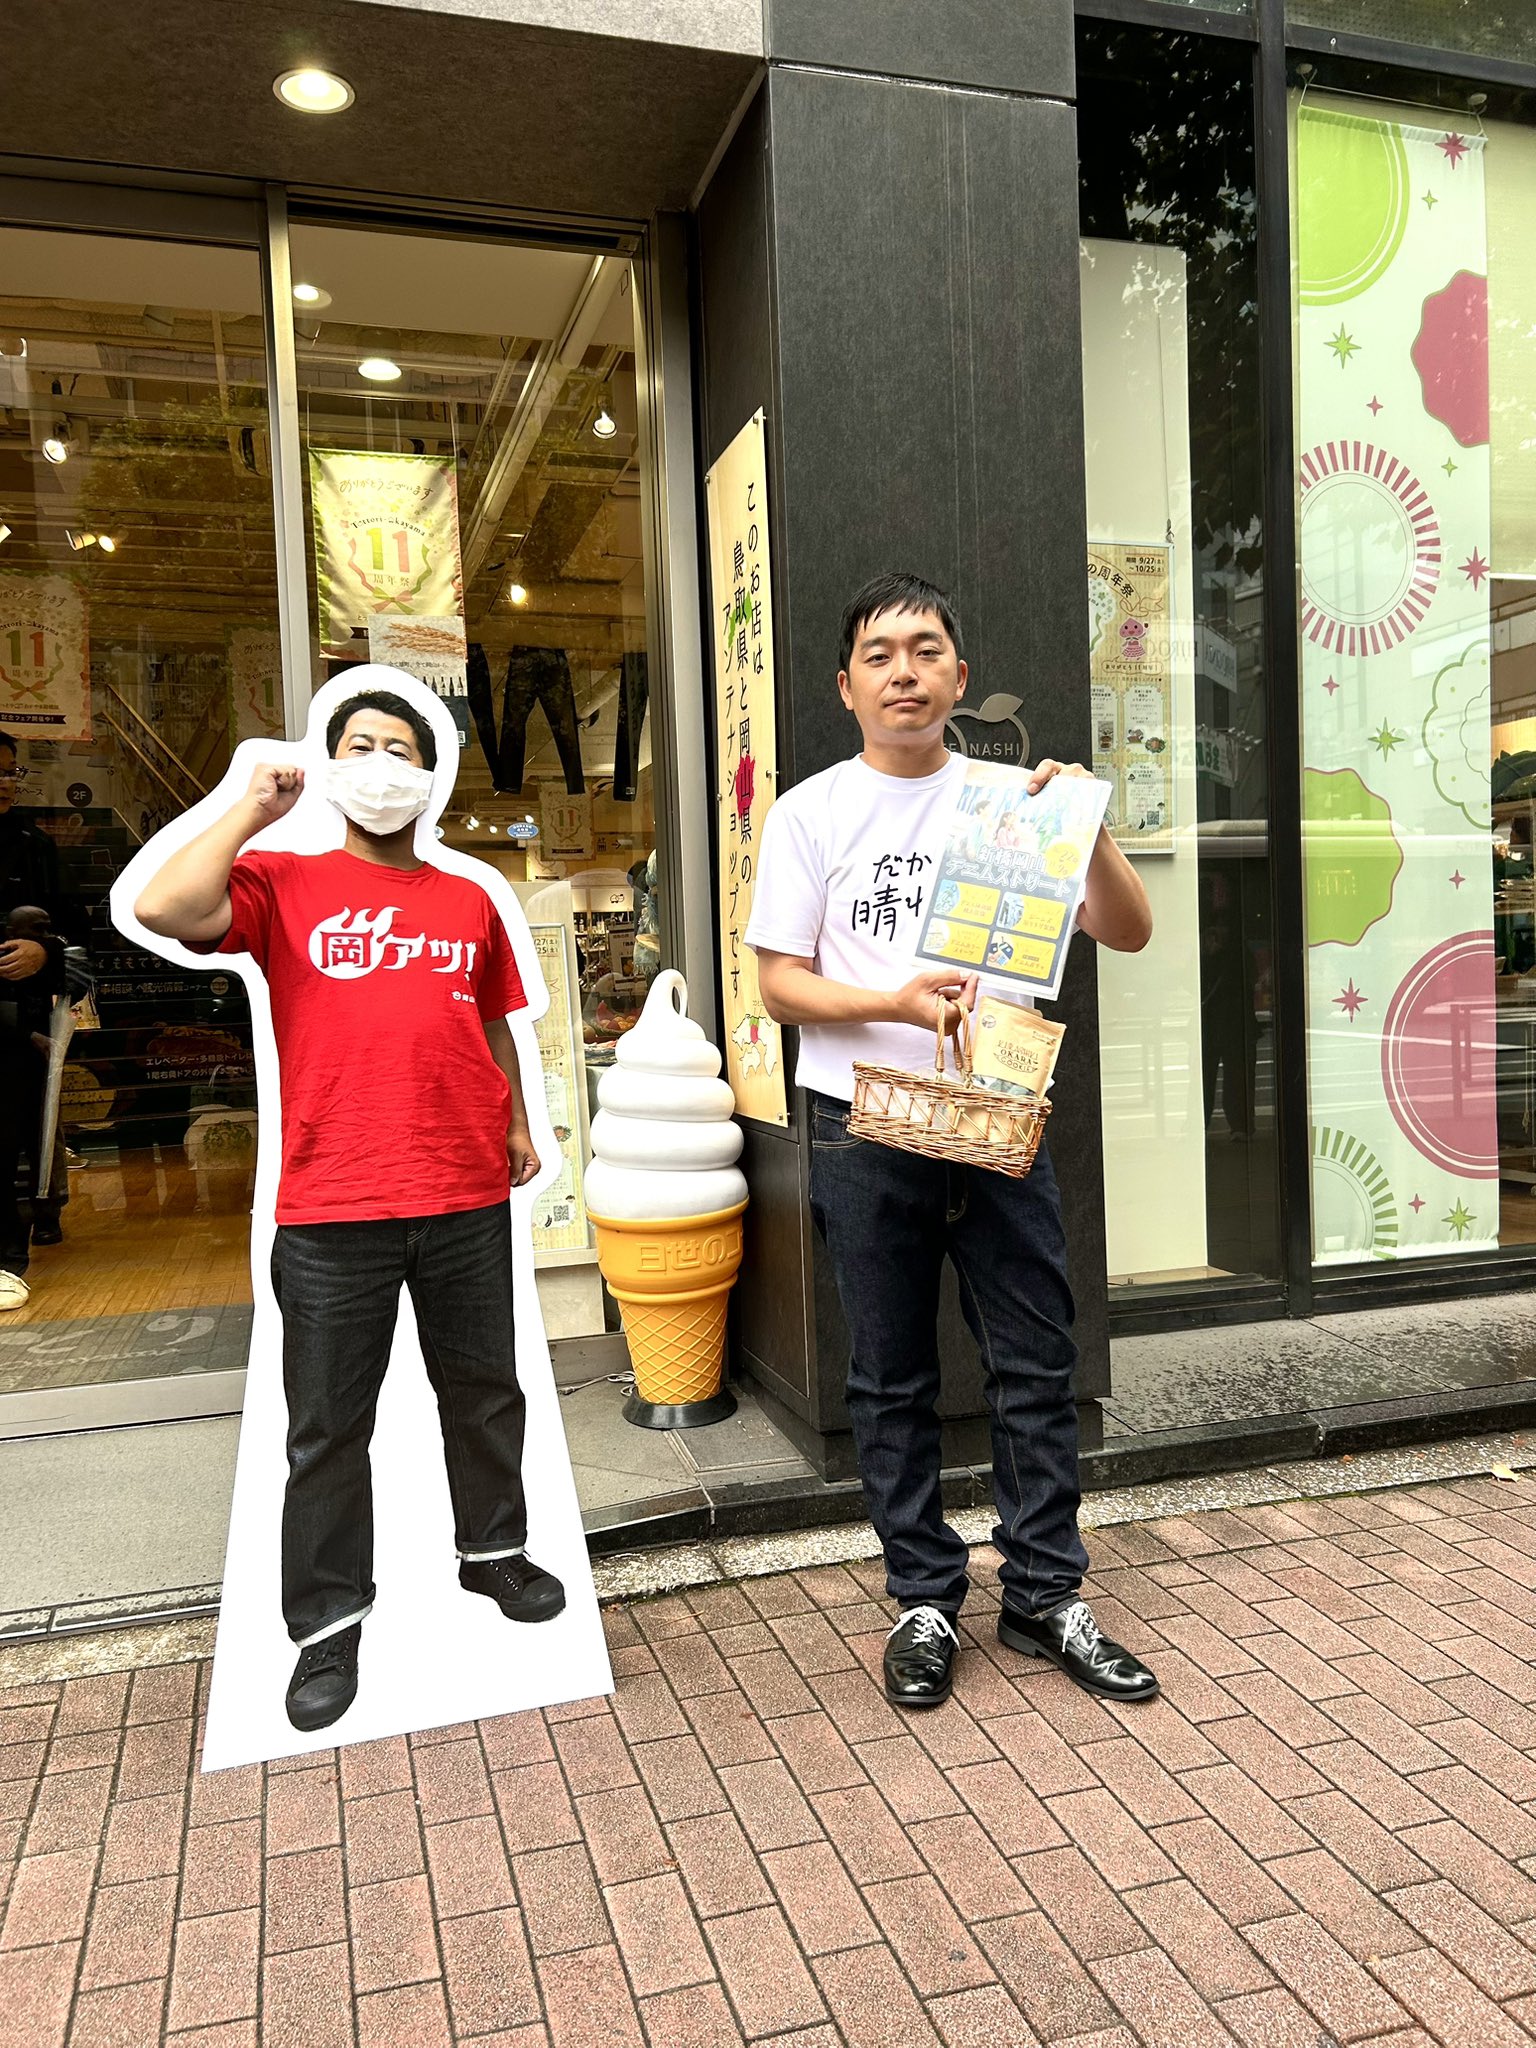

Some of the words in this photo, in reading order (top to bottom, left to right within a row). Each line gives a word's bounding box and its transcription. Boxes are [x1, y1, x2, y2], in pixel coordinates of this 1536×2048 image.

[338, 479, 434, 501] ありがとうございます
[366, 528, 411, 574] 11
[373, 573, 410, 587] 周年祭
[747, 482, 764, 675] このお店は
[733, 540, 753, 885] 鳥取県と岡山県の
[969, 743, 1020, 756] NASHI
[73, 790, 88, 801] 2F
[722, 602, 740, 999] アンテナショップです
[976, 844, 1047, 875] 新橋岡山
[945, 857, 1071, 897] デニムストリート
[1000, 1049, 1032, 1066] OKARA
